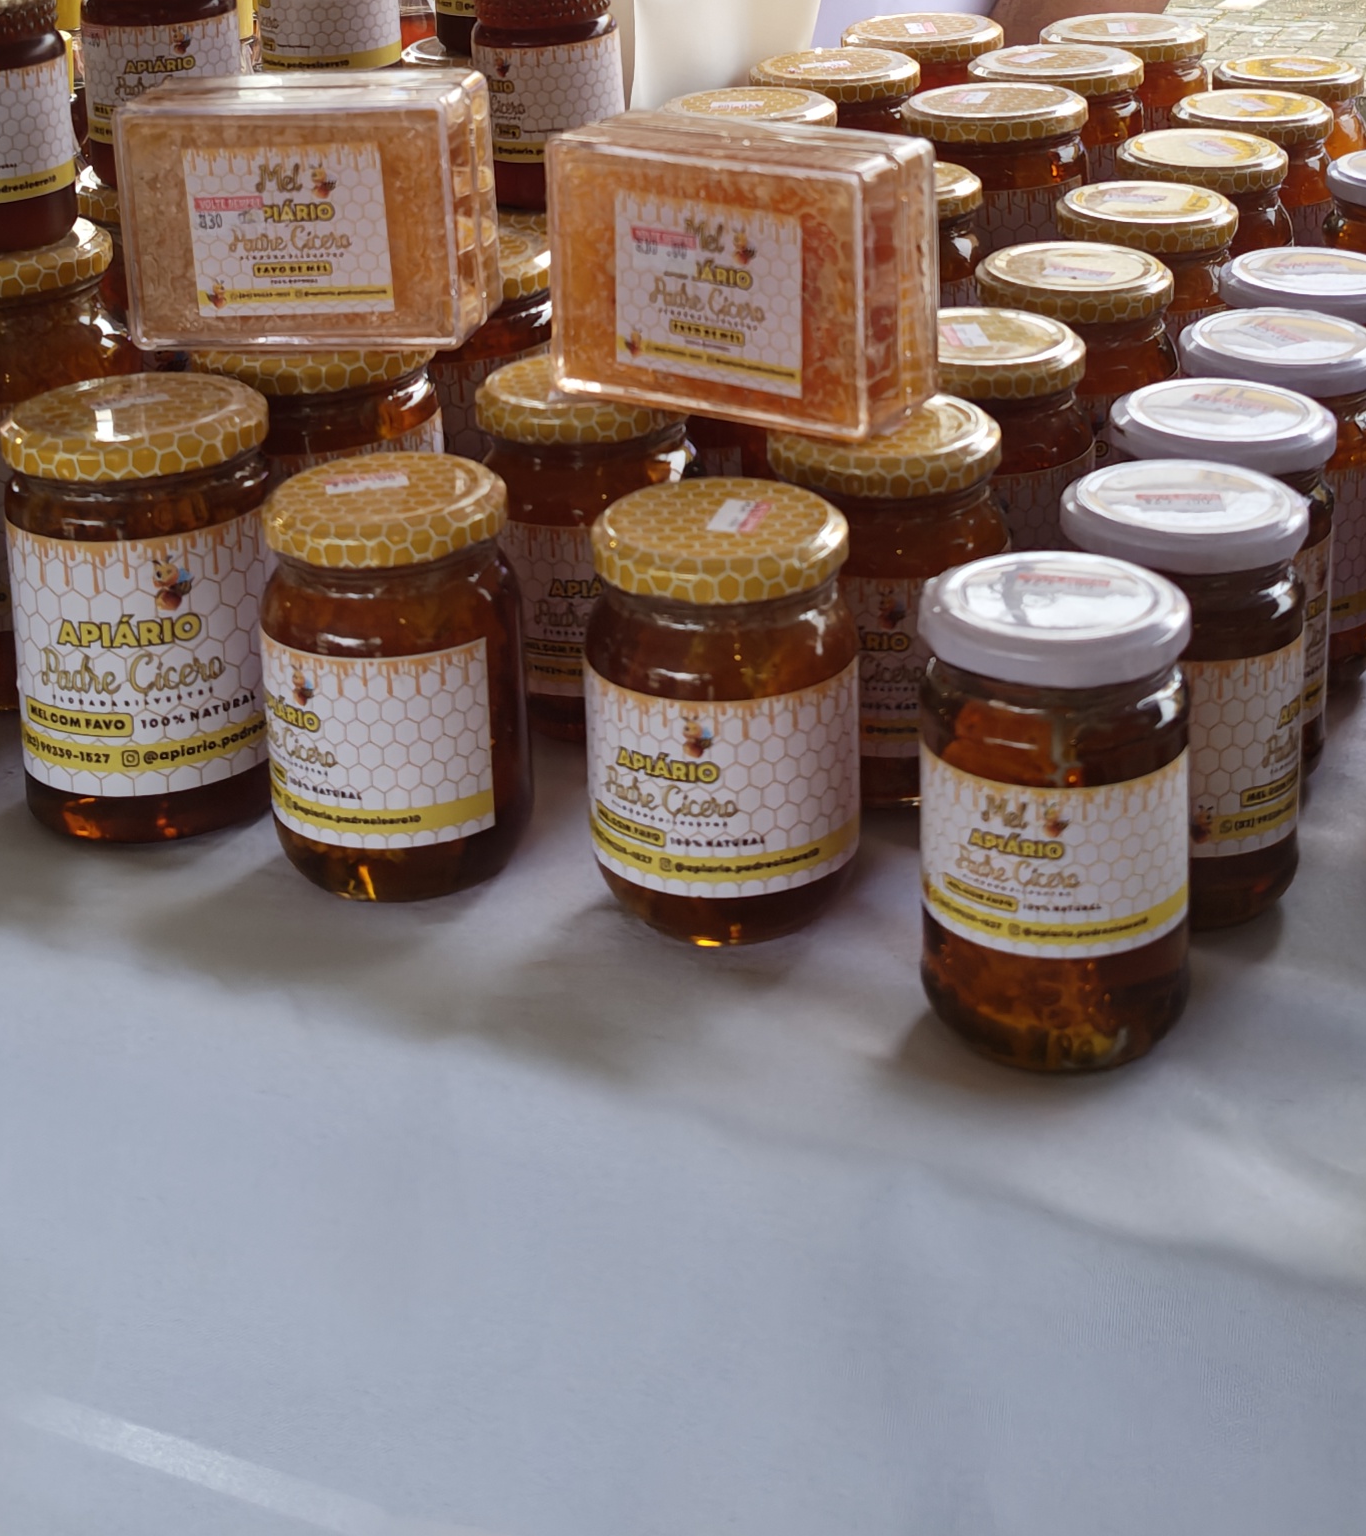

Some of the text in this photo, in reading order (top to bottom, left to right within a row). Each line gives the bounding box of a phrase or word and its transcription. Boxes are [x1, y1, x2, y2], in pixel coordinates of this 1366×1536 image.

[123, 55, 196, 75] APIÁRIO
[255, 163, 303, 194] Mel
[263, 199, 336, 224] PIÁRIO
[549, 574, 604, 599] APIÁ
[57, 612, 202, 649] APIÁRIO
[41, 647, 121, 695] Padre
[30, 692, 257, 731] MEL COM FAVO 100% NATURAL
[40, 740, 111, 764] 99339-1527
[616, 746, 720, 784] APIÁRIO
[312, 785, 362, 801] NATURAL
[981, 794, 1030, 830] Mel
[706, 835, 765, 848] NATURAL
[968, 829, 1065, 860] APIÁRIO
